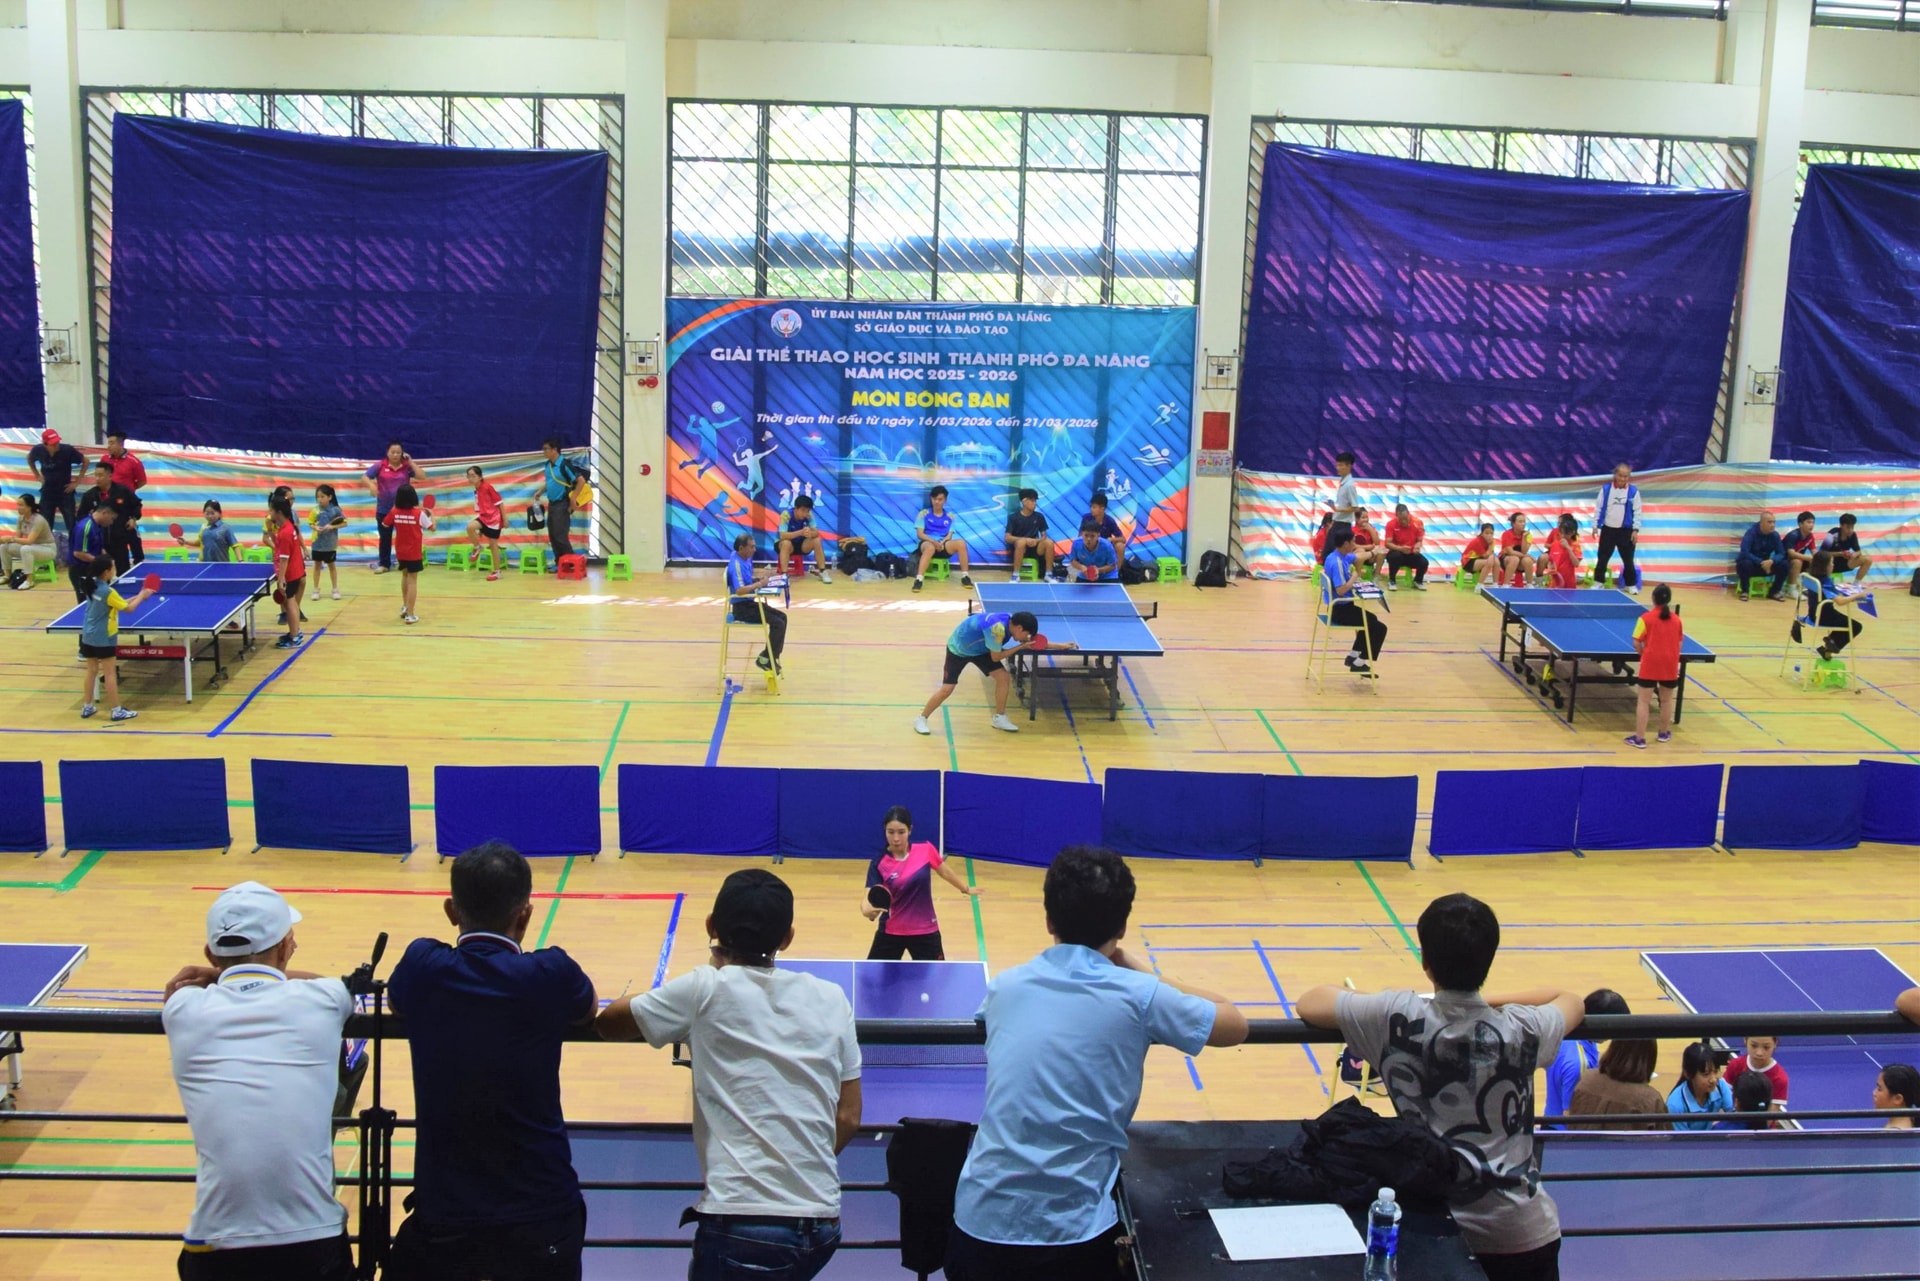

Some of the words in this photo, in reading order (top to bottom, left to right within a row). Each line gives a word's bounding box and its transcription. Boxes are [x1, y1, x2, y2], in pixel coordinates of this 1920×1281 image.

[830, 310, 854, 319] BAN
[858, 309, 893, 320] NHÂN
[896, 310, 921, 320] DÂN
[925, 311, 966, 321] THÀNH
[969, 310, 994, 321] PHỐ
[997, 311, 1014, 321] ĐÀ
[874, 322, 905, 333] GIÁO
[908, 324, 933, 335] DỤC
[936, 323, 952, 334] VÀ
[954, 323, 981, 334] ĐÀO
[984, 325, 1009, 336] TẠO
[710, 345, 752, 361] GIẢI
[794, 349, 850, 364] THAO
[853, 350, 895, 366] HỌC
[898, 352, 940, 365] SINH
[888, 368, 924, 381] HỌC
[927, 369, 966, 381] 2025
[978, 370, 1018, 382] 2026
[851, 389, 900, 407] MÔN
[756, 413, 783, 423] Thời
[785, 415, 814, 426] gian
[817, 415, 834, 424] thi
[837, 413, 862, 425] đấu
[865, 415, 880, 425] từ
[881, 415, 915, 428] ngày
[918, 416, 993, 427] 16/03/2026
[995, 416, 1020, 427] đến
[1022, 417, 1099, 429] 21/03/2026
